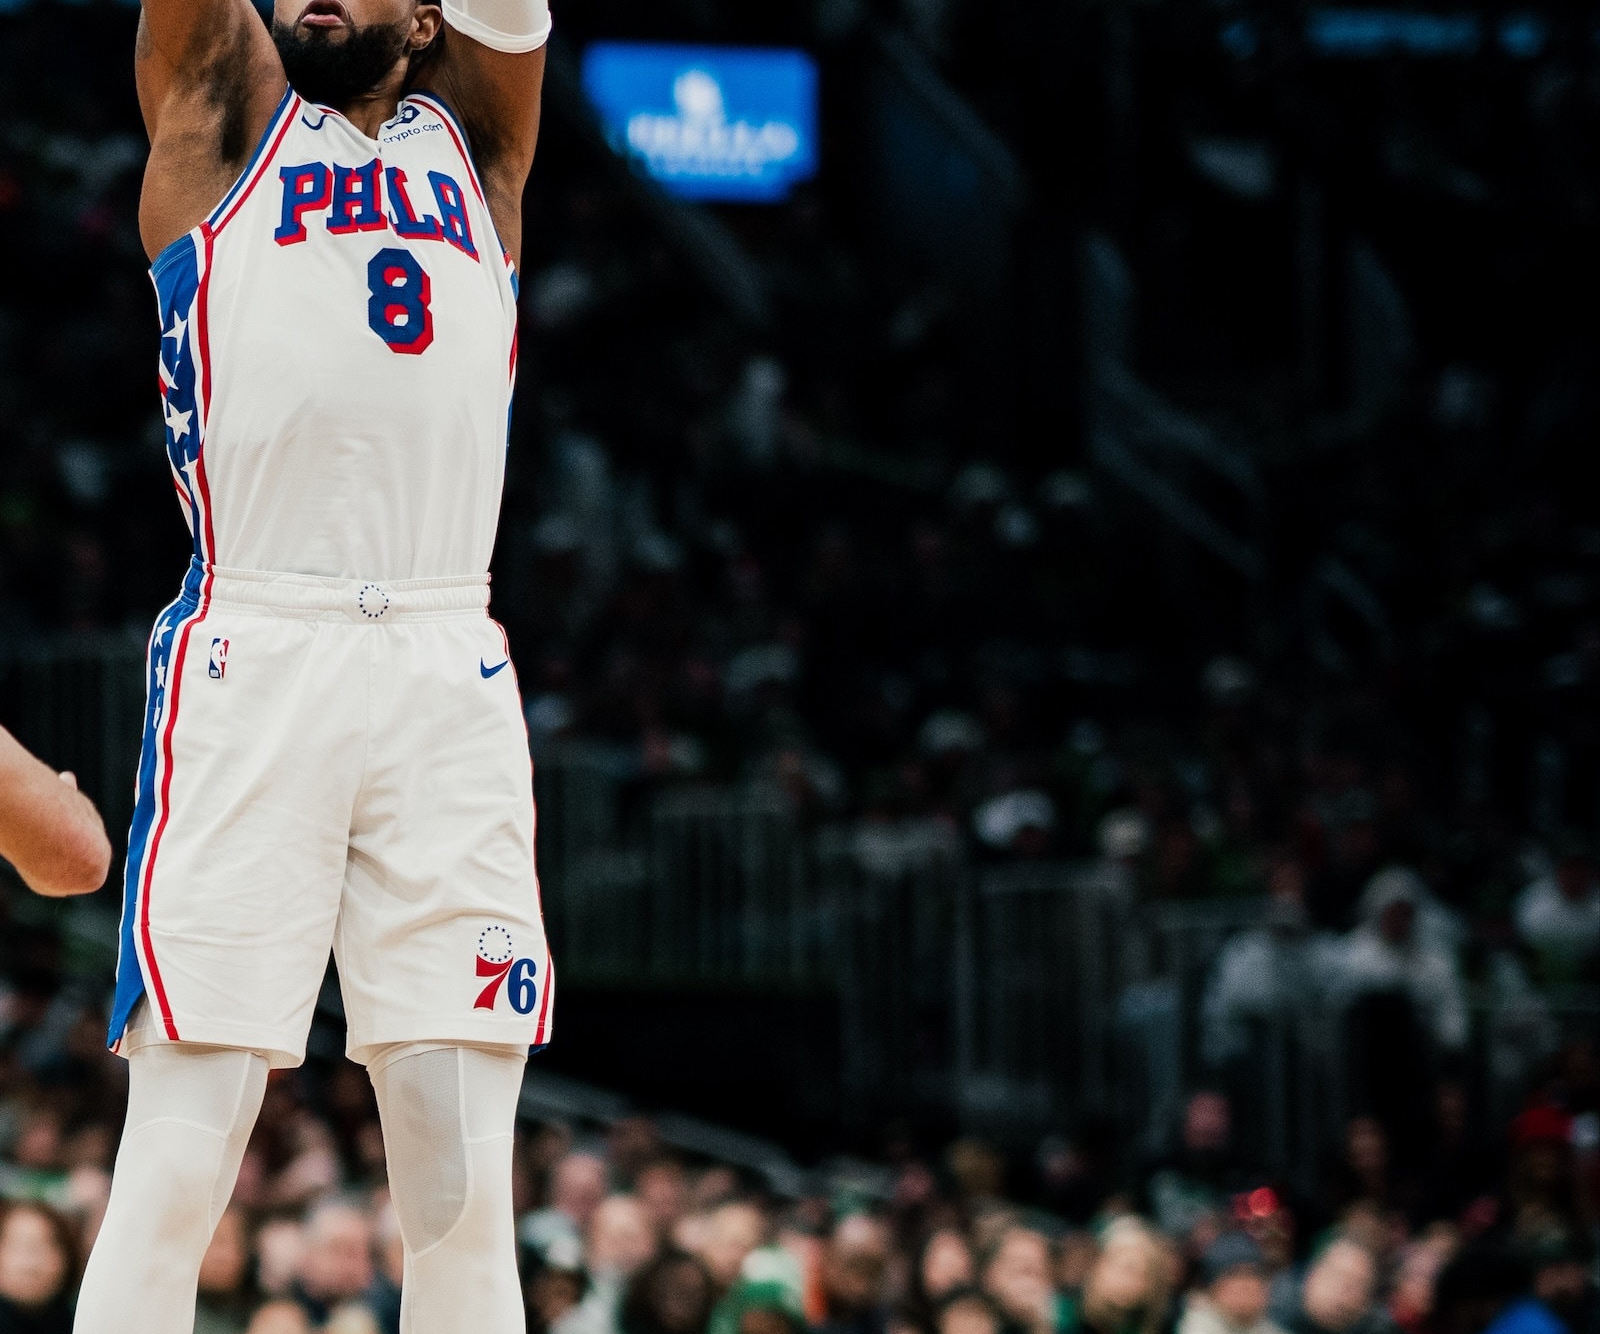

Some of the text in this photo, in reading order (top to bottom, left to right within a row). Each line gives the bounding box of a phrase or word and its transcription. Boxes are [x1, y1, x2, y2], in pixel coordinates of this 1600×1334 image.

[383, 121, 444, 144] crypto.com
[273, 157, 481, 265] PHLA
[367, 247, 434, 356] 8
[473, 953, 538, 1016] 76
